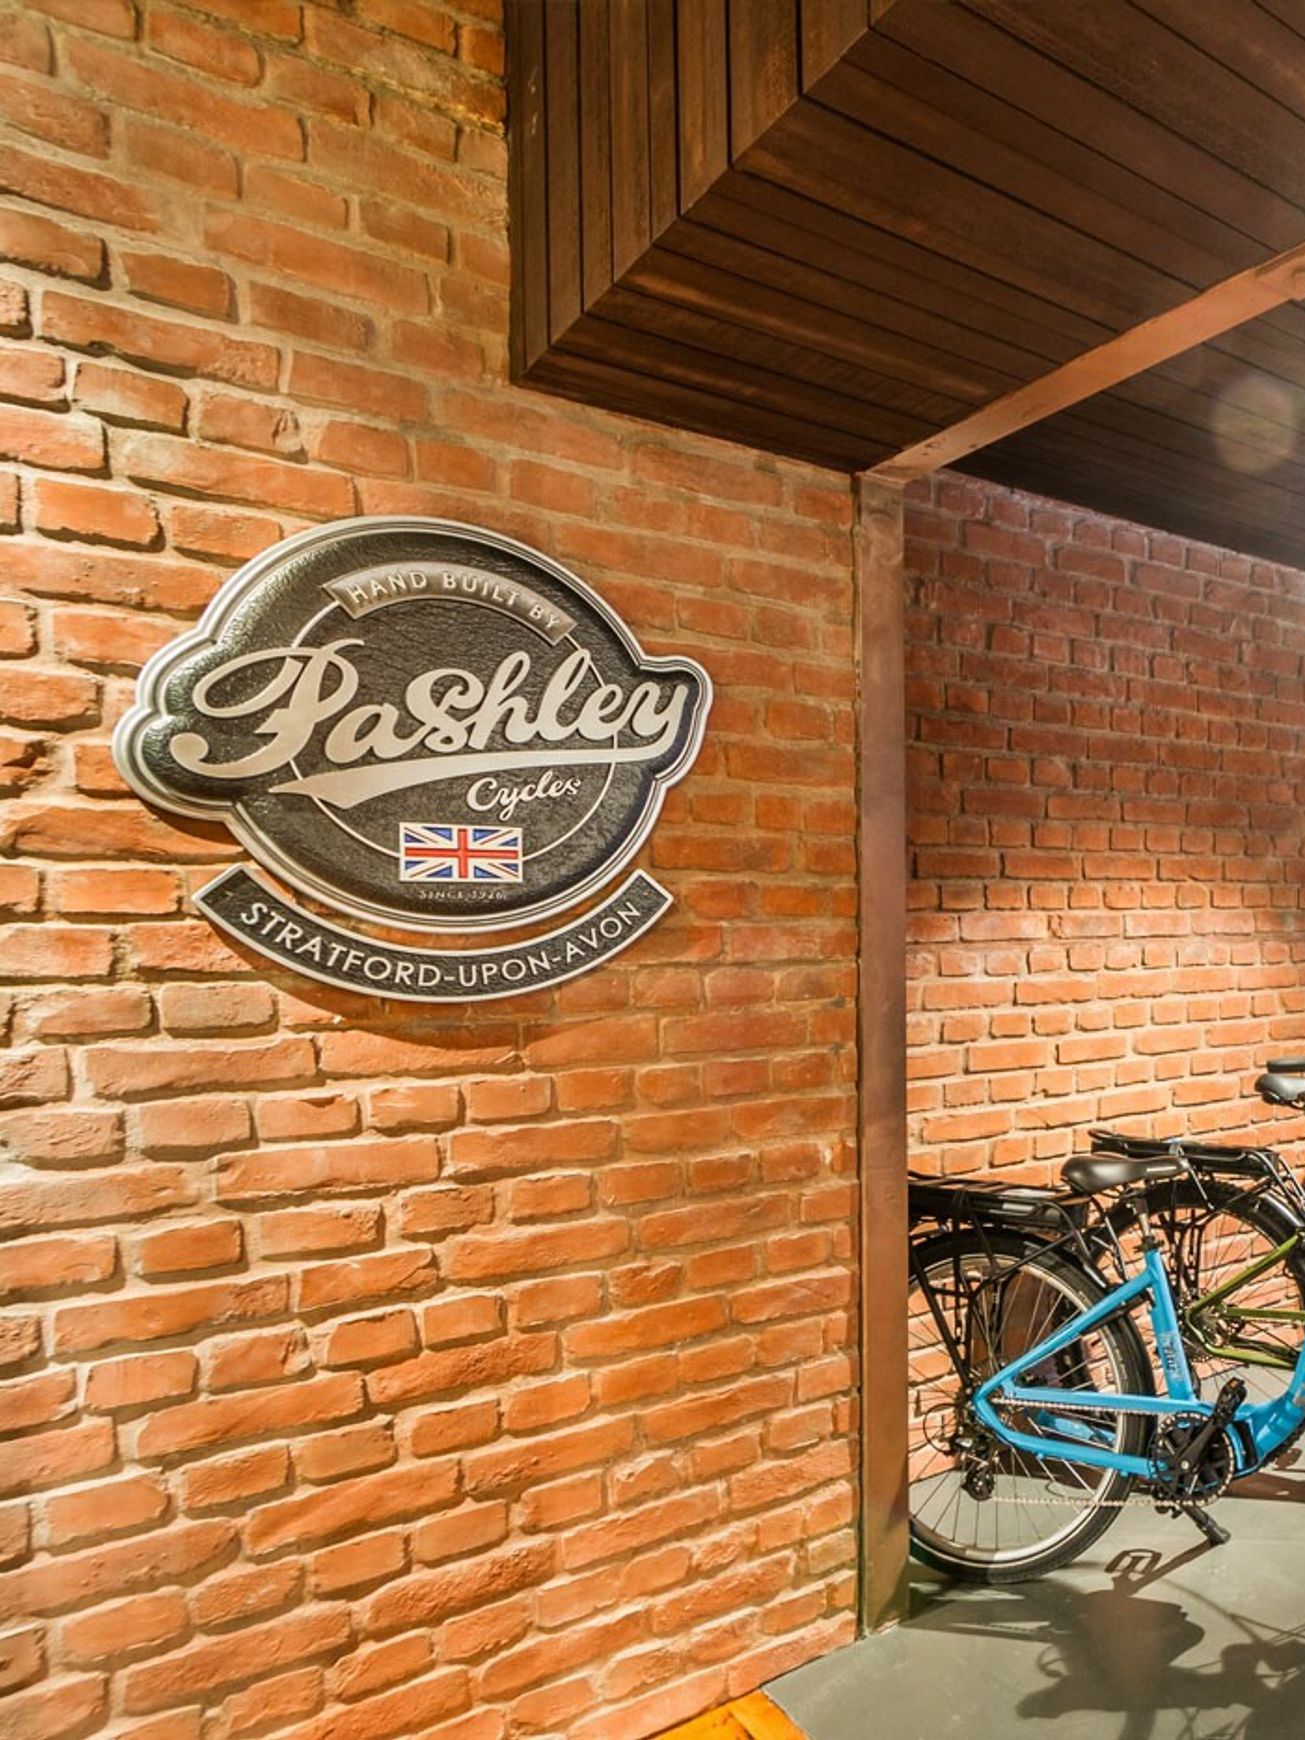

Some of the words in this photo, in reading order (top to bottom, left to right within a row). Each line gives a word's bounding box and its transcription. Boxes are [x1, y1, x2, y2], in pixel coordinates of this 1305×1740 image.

[348, 570, 428, 604] HAND
[443, 571, 520, 607] BUILT
[528, 605, 561, 630] BY
[169, 638, 688, 778] Pashley
[465, 774, 582, 821] Cycles
[240, 900, 642, 988] STRATFORD-UPON-AVON
